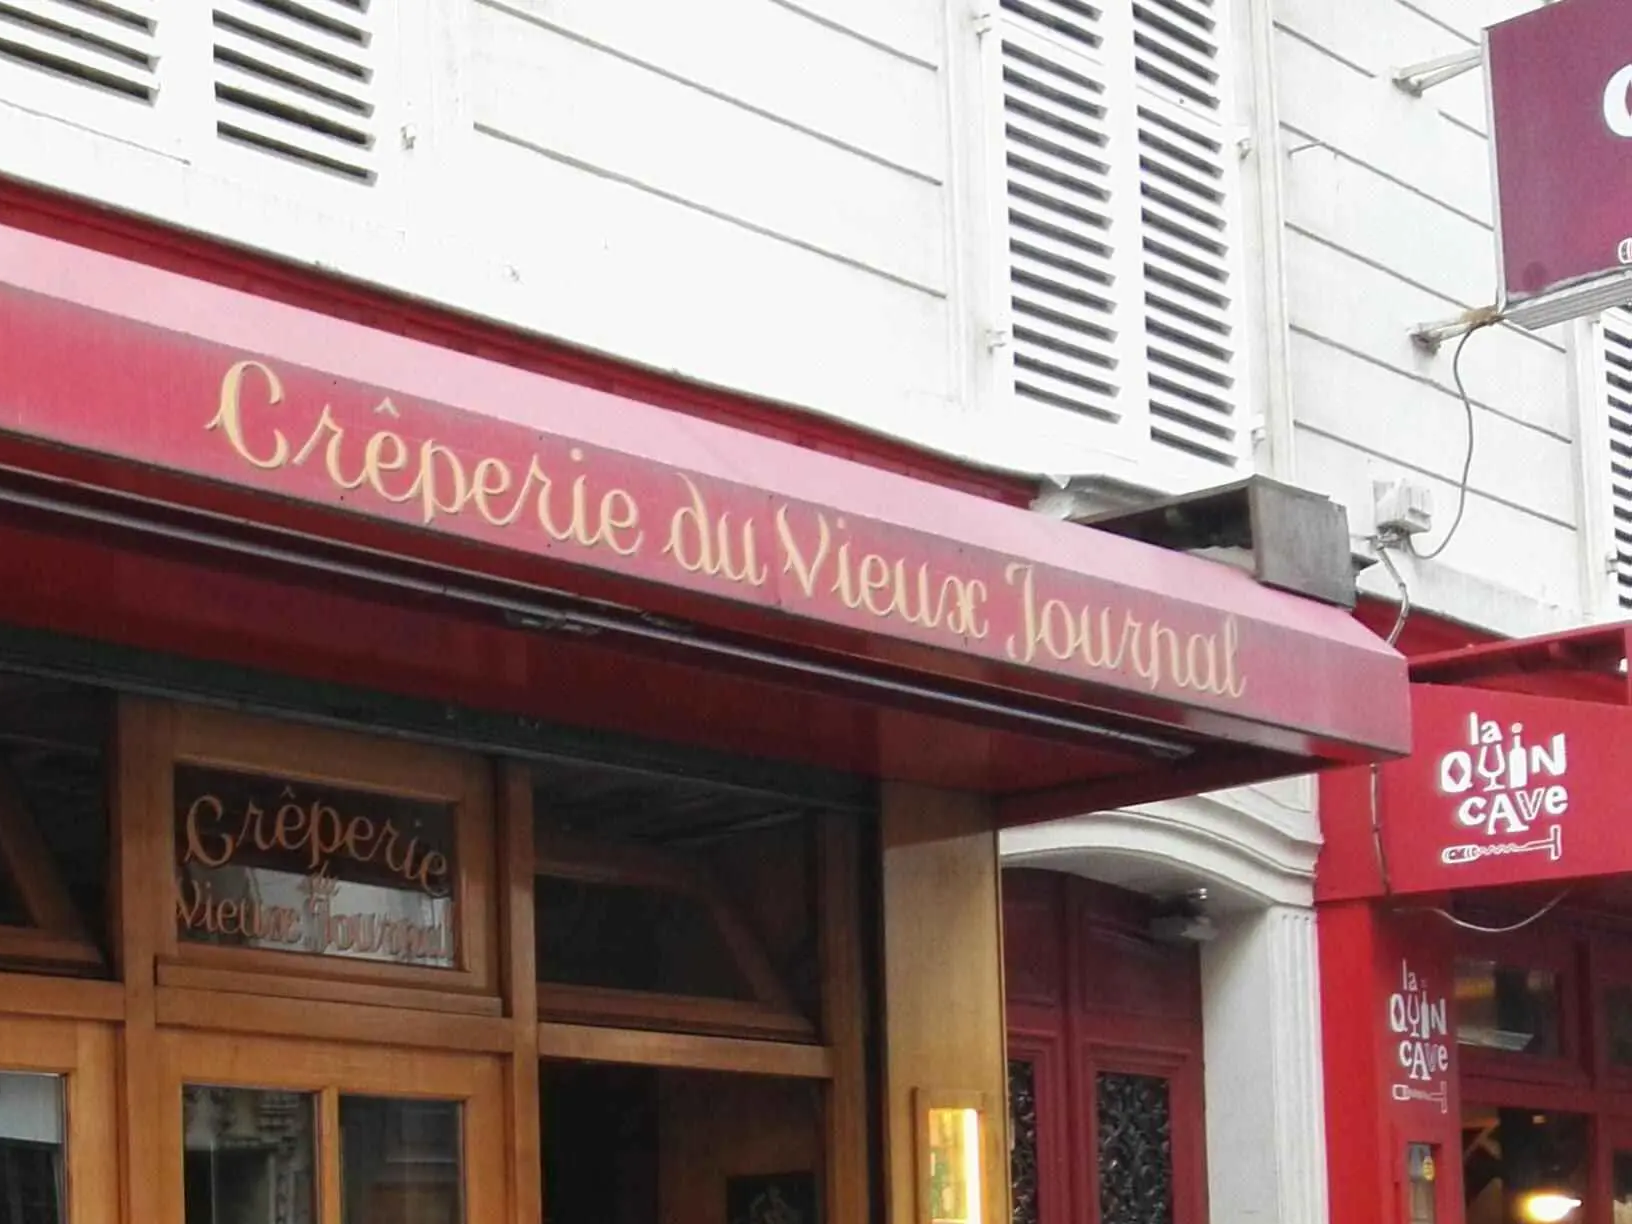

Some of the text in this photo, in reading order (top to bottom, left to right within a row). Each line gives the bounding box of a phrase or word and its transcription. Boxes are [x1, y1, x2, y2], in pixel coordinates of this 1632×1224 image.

[203, 360, 1246, 698] Crêperie du Vieux Journal
[1470, 711, 1503, 746] la
[184, 784, 450, 897] Crêperie
[1402, 957, 1418, 991] la
